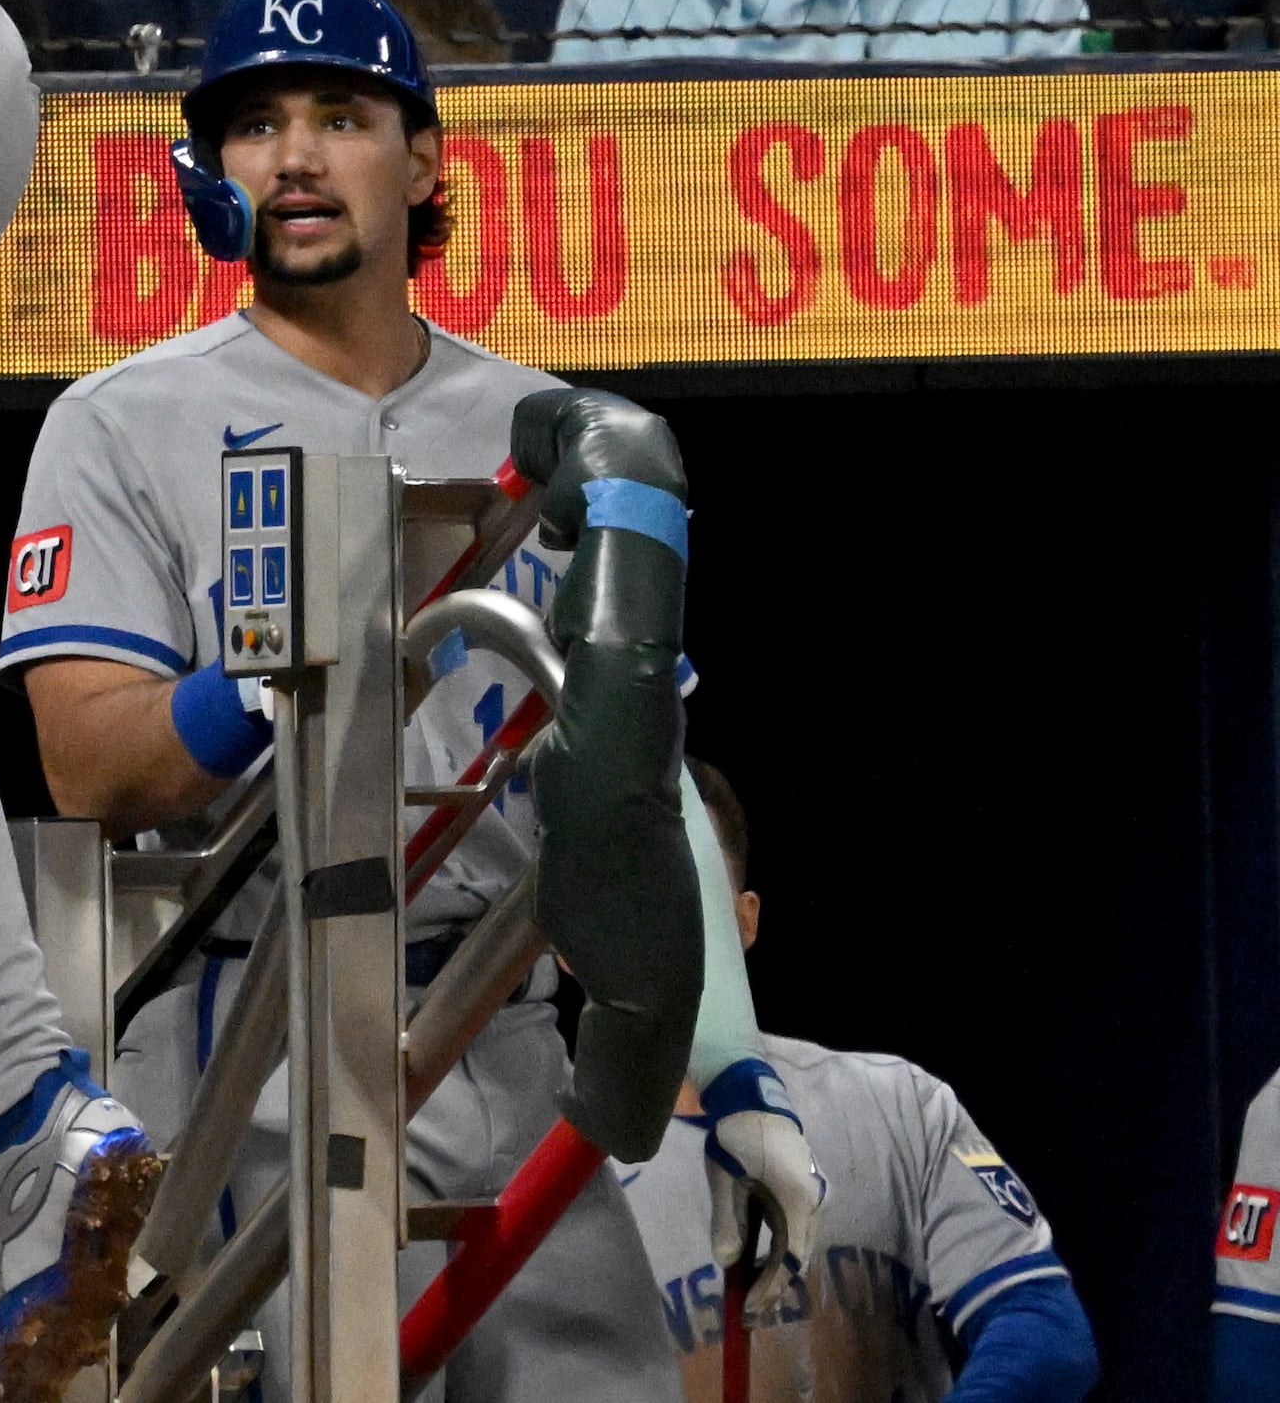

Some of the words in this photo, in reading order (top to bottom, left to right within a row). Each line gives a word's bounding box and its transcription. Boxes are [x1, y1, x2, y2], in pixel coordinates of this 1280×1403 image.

[91, 129, 632, 347] BOU
[722, 103, 1256, 328] SOME.
[14, 535, 65, 597] QT
[1226, 1191, 1272, 1249] QT
